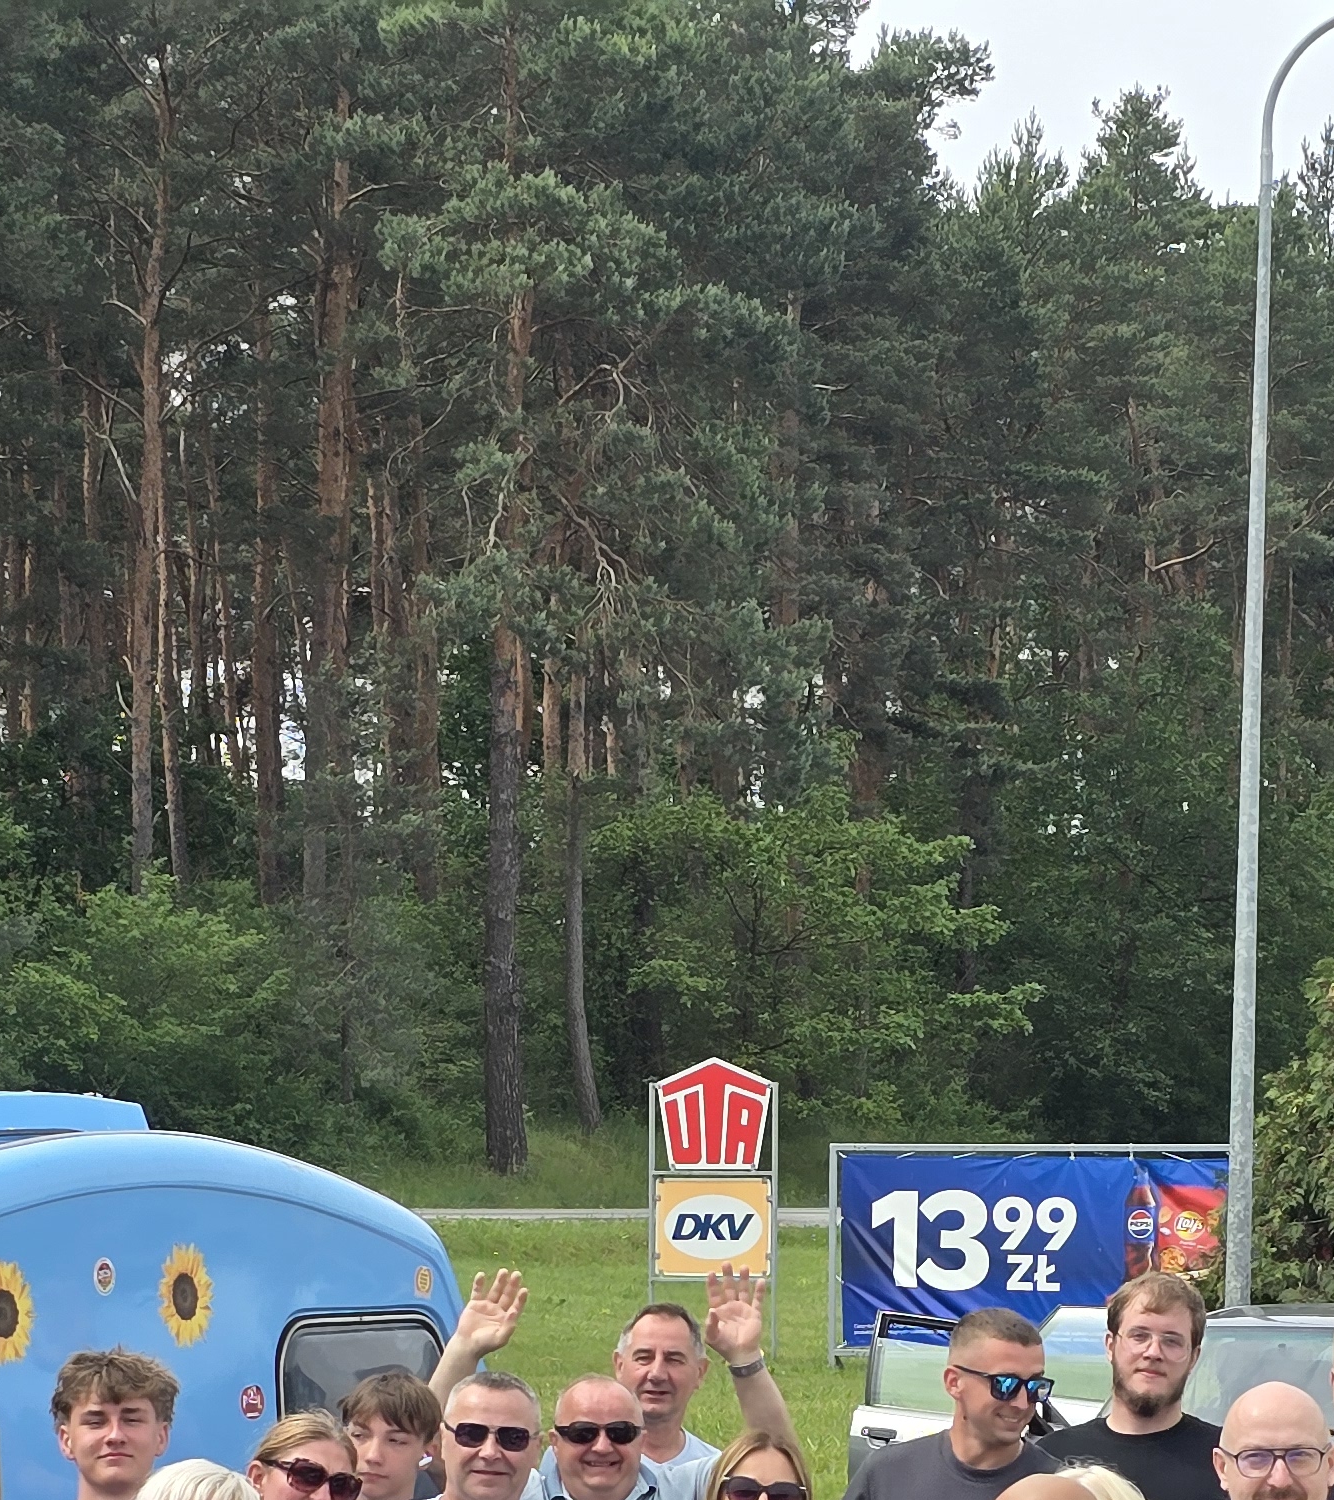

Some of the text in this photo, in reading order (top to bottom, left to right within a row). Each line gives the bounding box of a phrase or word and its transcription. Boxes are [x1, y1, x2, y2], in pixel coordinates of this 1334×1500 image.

[662, 1063, 770, 1165] UTA
[671, 1212, 755, 1241] DKV
[870, 1190, 1078, 1291] 13 99
[1006, 1254, 1062, 1292] ZŁ
